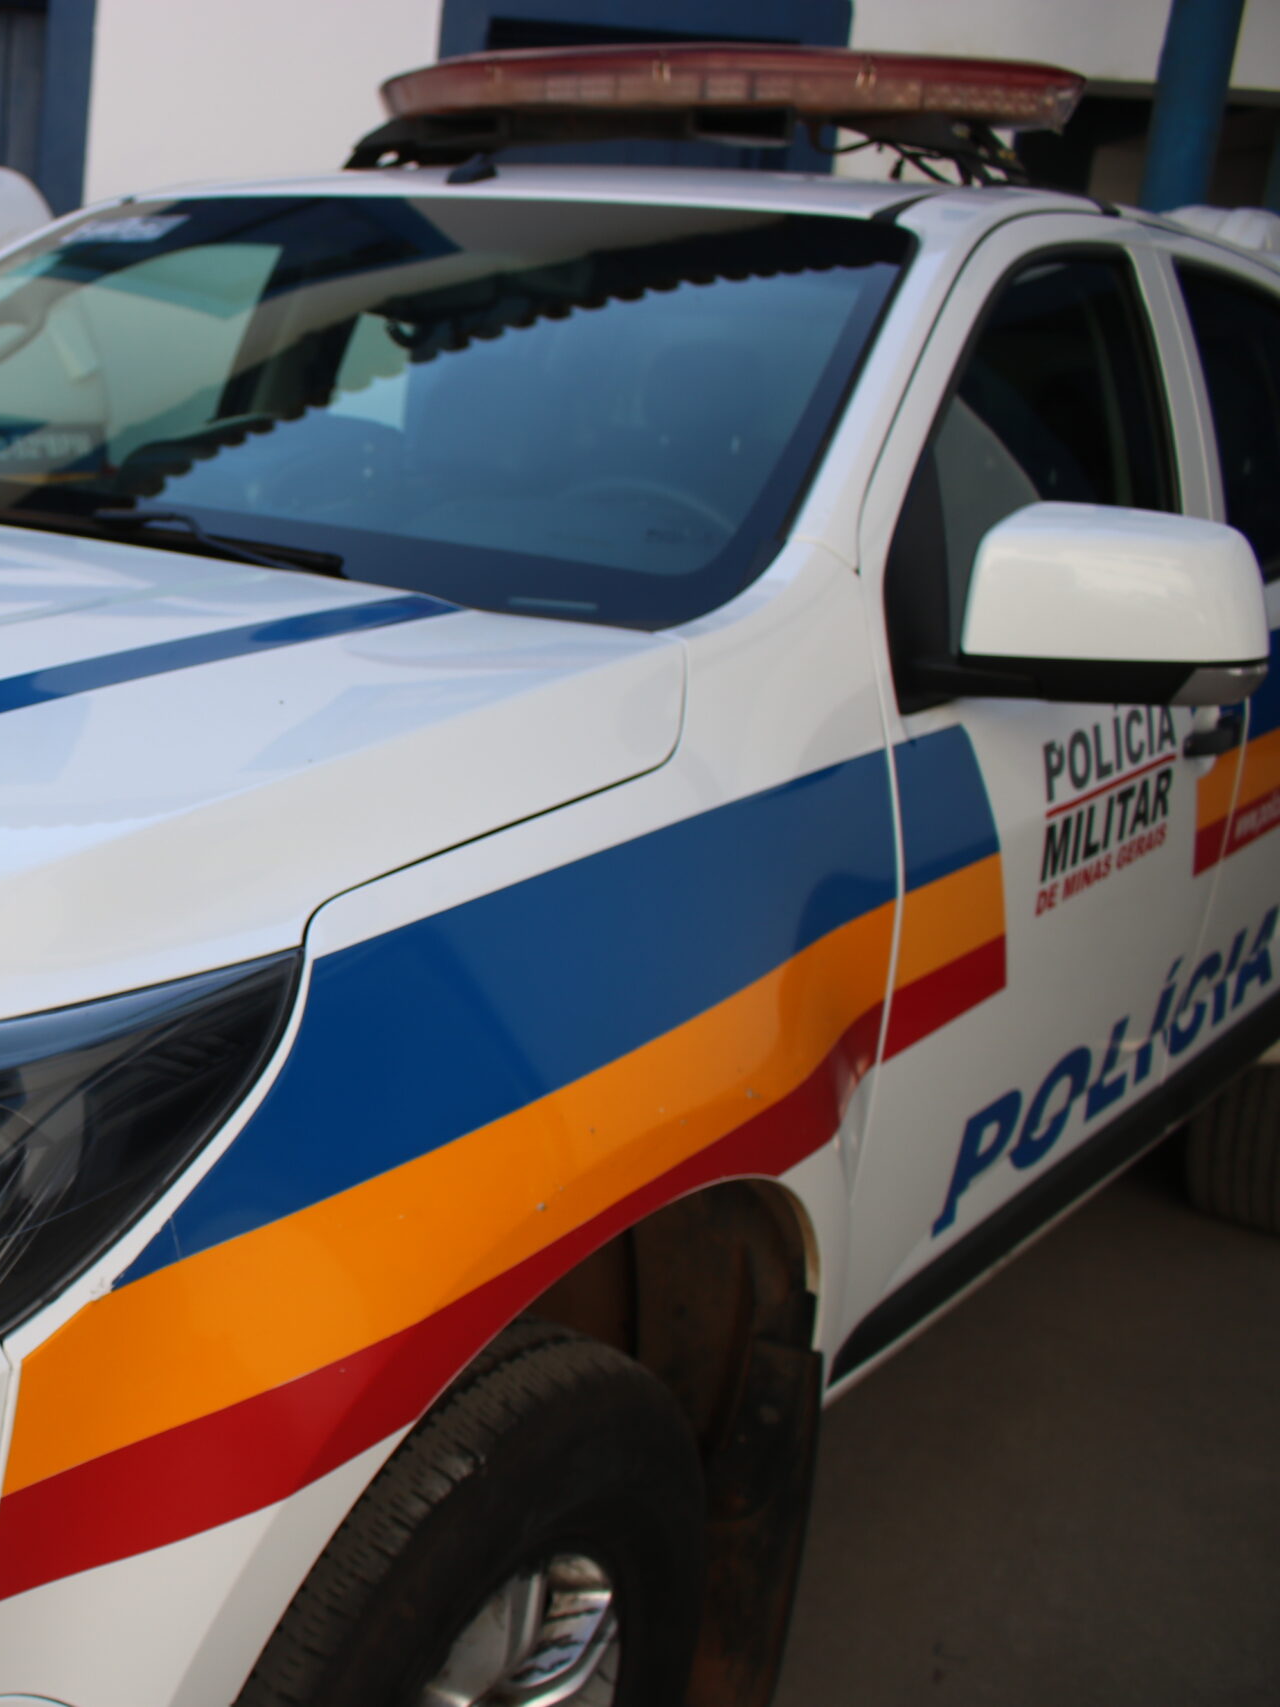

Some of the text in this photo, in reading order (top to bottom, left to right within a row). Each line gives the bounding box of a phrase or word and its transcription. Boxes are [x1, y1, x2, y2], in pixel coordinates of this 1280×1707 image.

[1042, 700, 1177, 802] POLÍCIA
[1035, 823, 1168, 917] DE MINAS GERAIS
[1040, 767, 1173, 883] MILITAR
[932, 904, 1280, 1240] POLÍCIA
